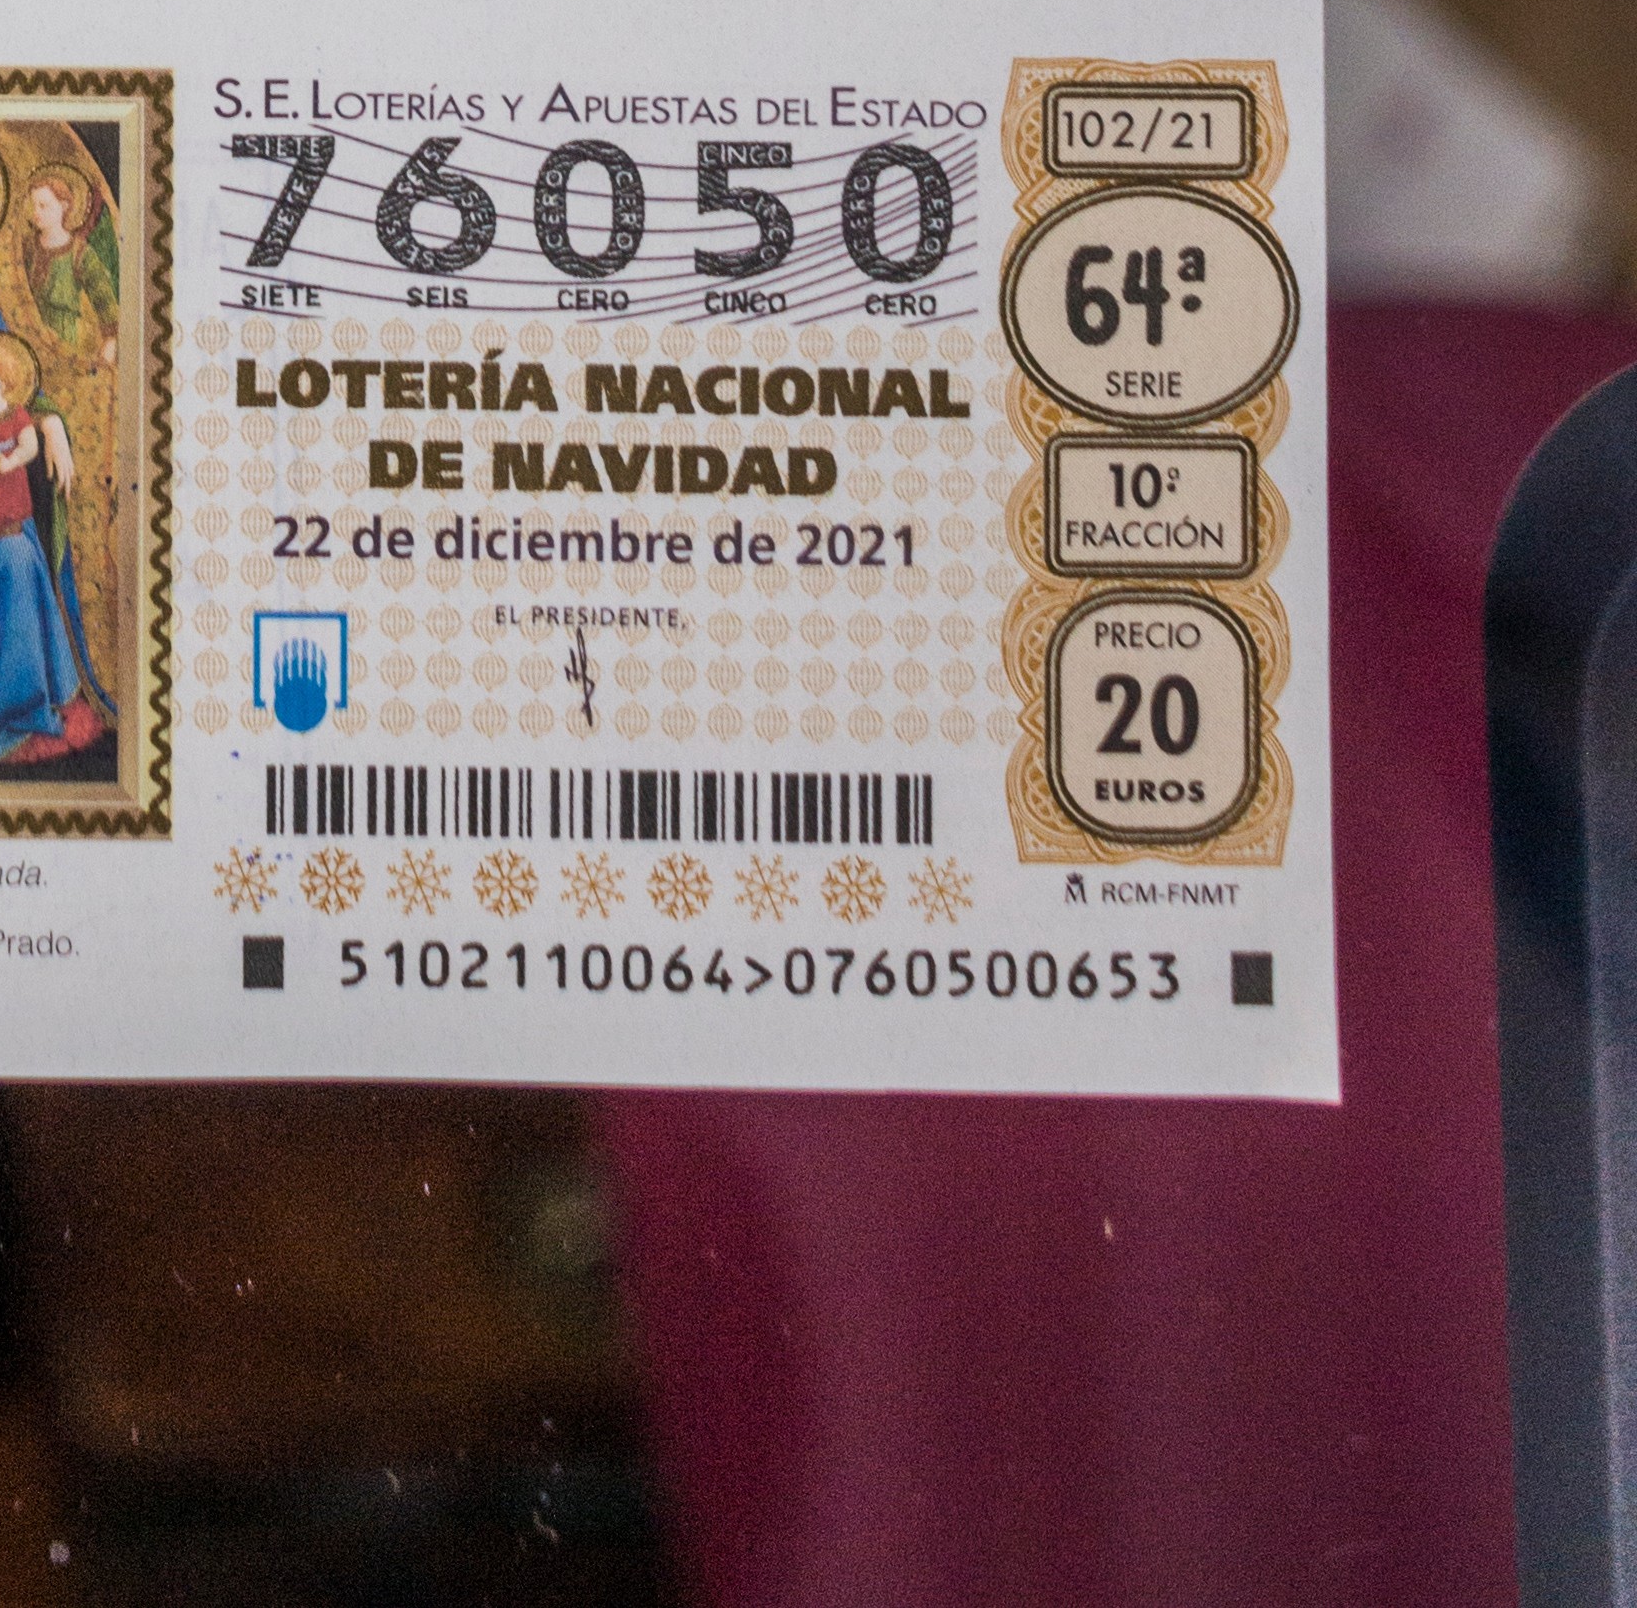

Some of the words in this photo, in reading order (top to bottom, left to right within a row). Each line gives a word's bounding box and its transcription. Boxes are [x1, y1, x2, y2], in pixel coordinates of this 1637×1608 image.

[1062, 107, 1213, 155] 102/21
[233, 133, 958, 284] 76050
[242, 282, 325, 308] SIETE
[407, 284, 473, 310] SEIS
[559, 286, 633, 312] CERO
[706, 290, 791, 315] CINCO
[868, 292, 942, 318] CERO
[231, 347, 558, 413] LOTERÍA
[584, 362, 971, 421] NACIONAL
[1105, 370, 1183, 398] SERIE
[367, 439, 463, 492] DE
[491, 441, 838, 498] NAVIDAD
[1066, 515, 1225, 550] FRACCIÓN
[1093, 673, 1200, 756] 20
[1095, 779, 1206, 804] EUROS
[340, 940, 1180, 1001] 5102110064>0760500653
